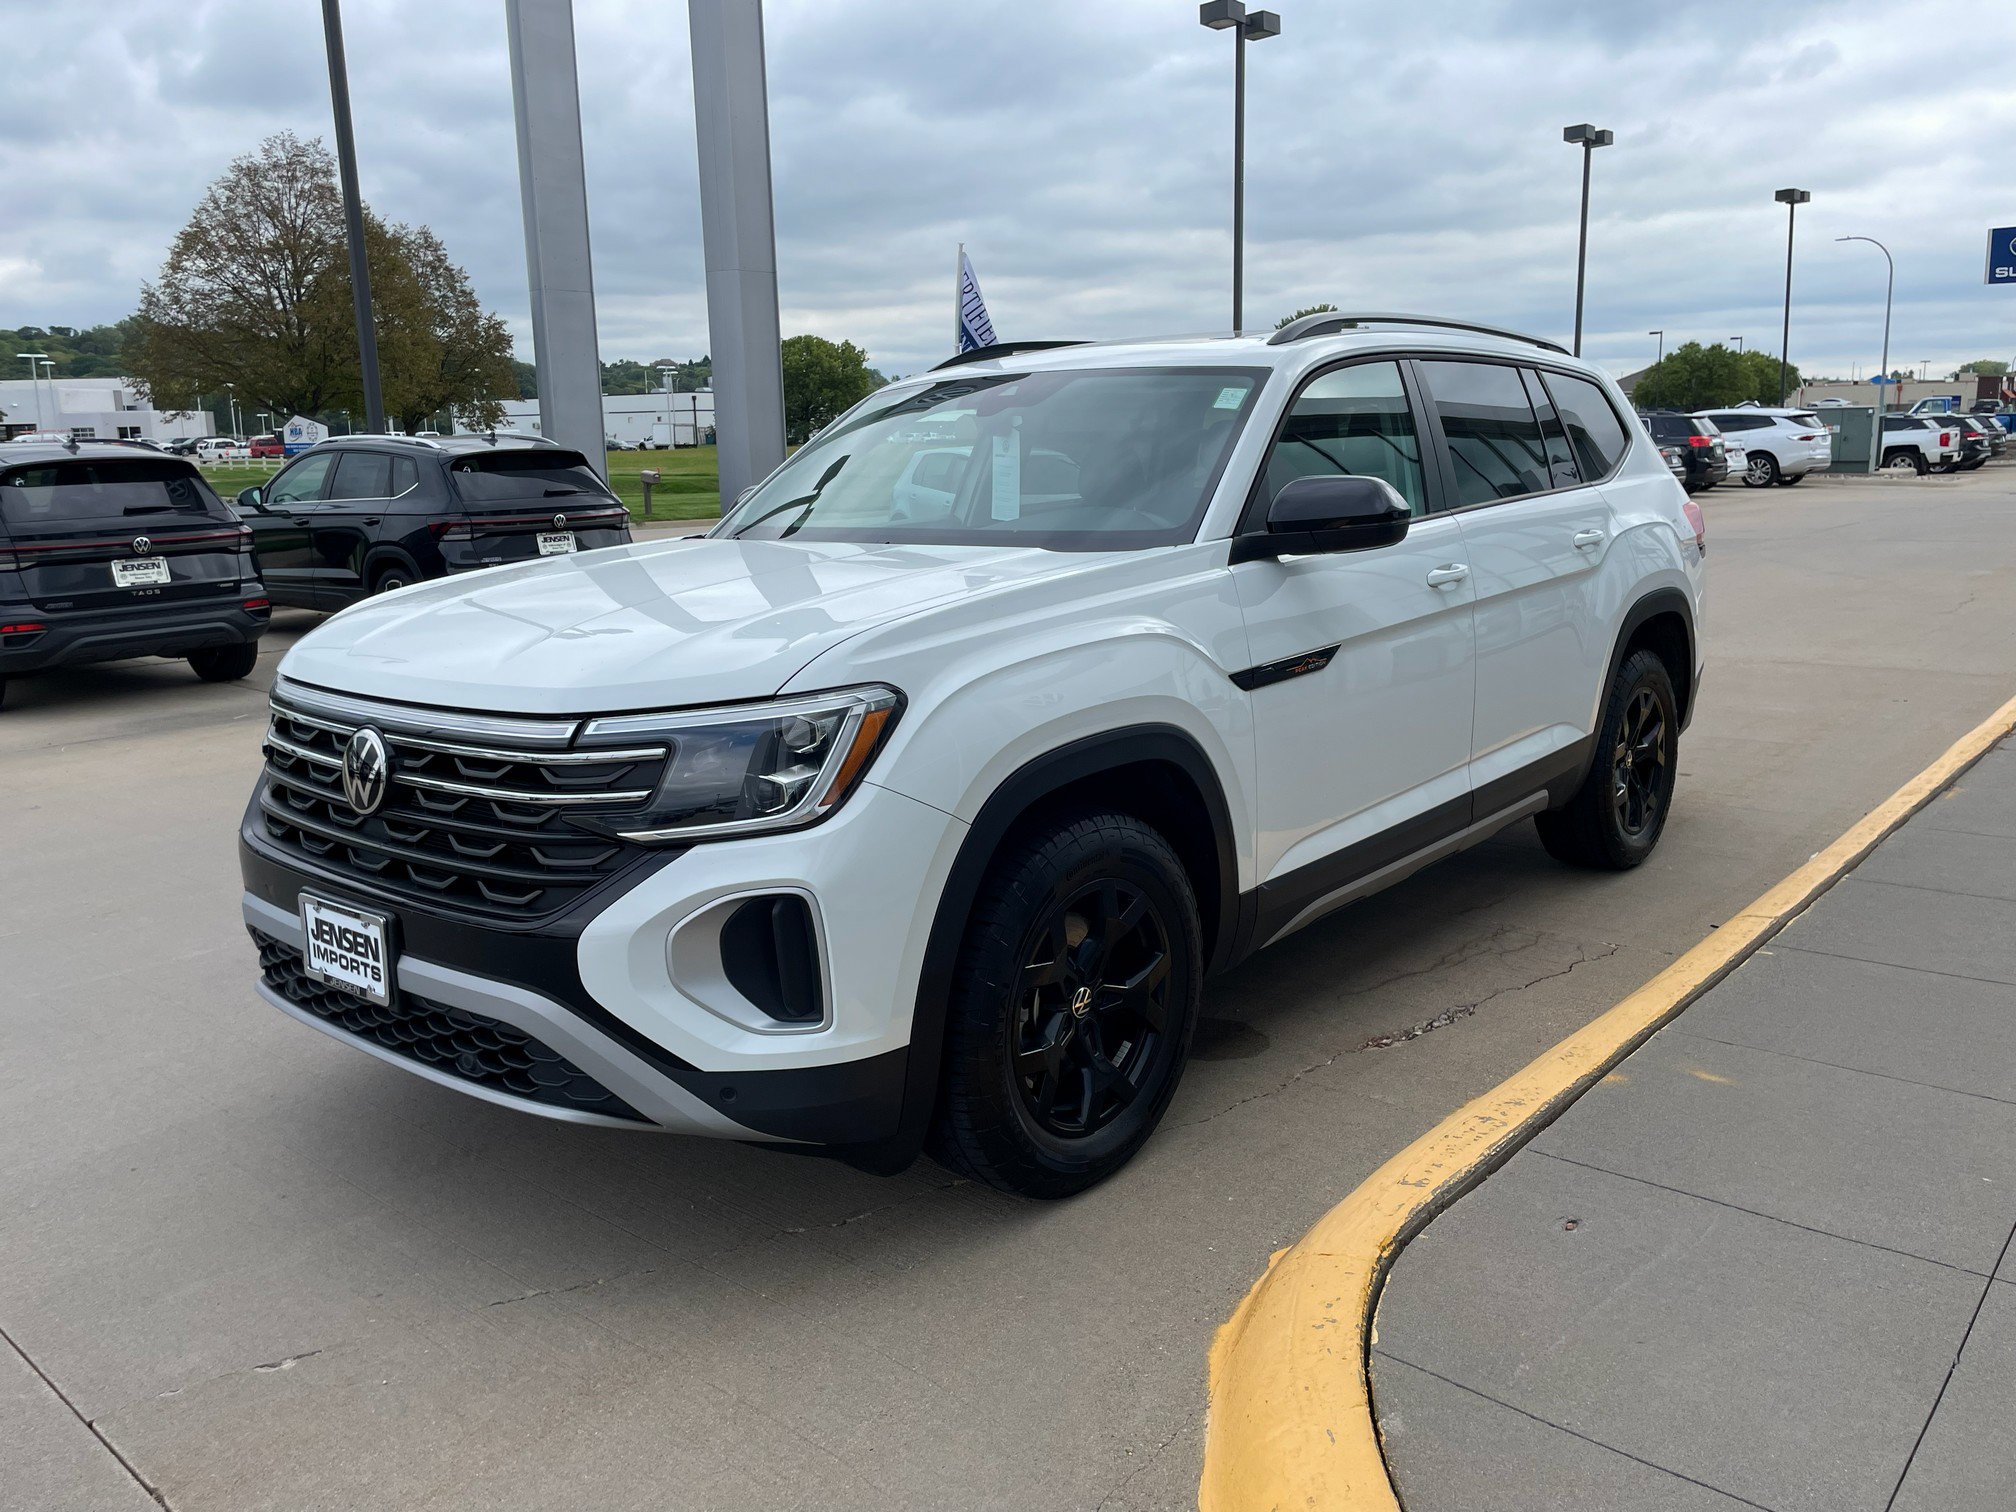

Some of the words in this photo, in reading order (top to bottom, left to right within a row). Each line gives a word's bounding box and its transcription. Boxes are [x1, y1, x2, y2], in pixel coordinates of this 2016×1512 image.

[541, 535, 570, 543] JENSEN
[119, 562, 161, 572] JENSEN
[311, 917, 380, 963] JENSEN
[313, 943, 381, 983] IMPORTS
[330, 977, 360, 995] JENSEN
